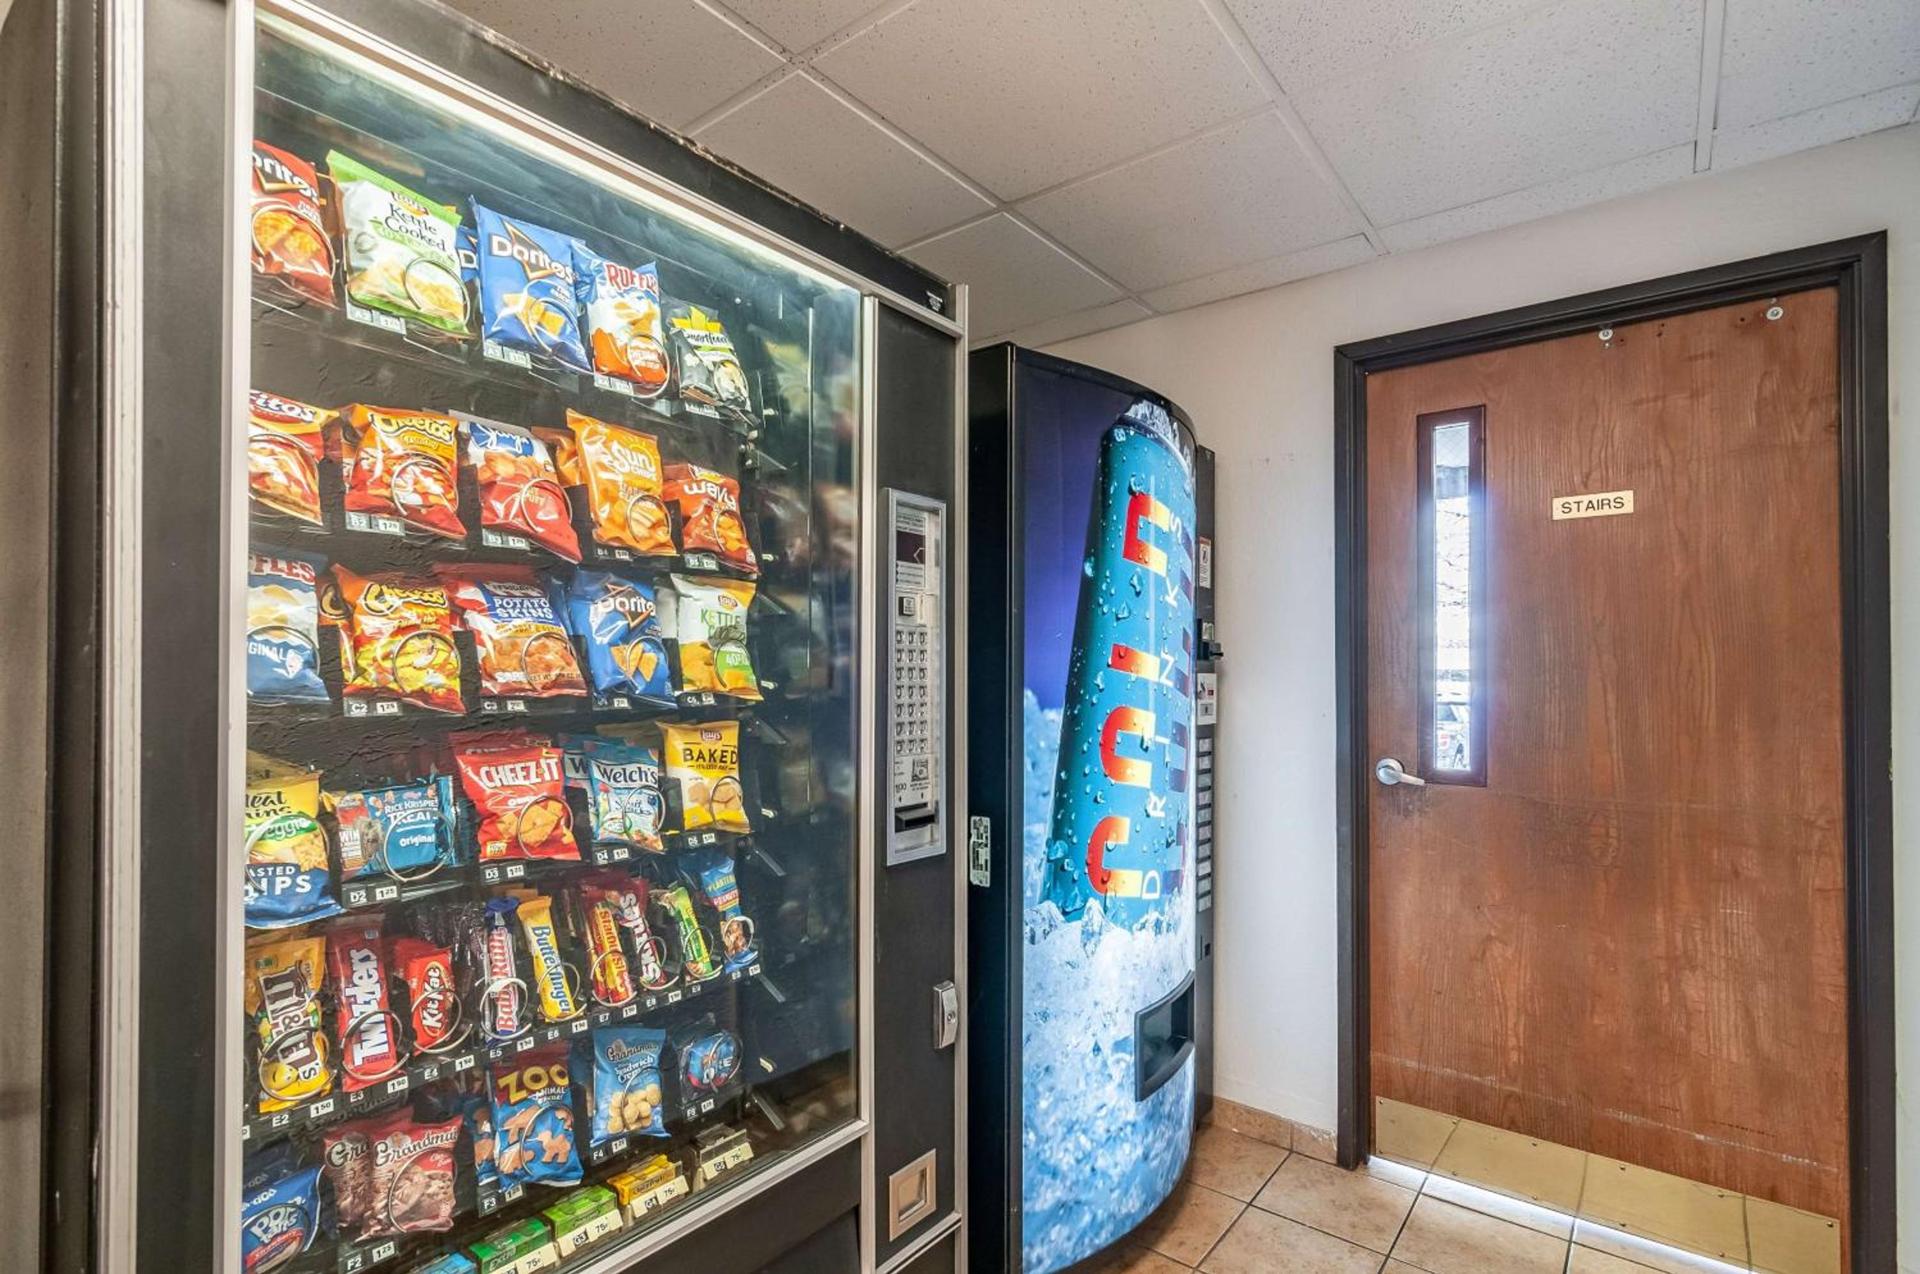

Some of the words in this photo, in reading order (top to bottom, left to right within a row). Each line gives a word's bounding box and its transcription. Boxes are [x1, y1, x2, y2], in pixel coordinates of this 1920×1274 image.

[252, 151, 320, 207] oritos
[389, 203, 438, 235] Kettle
[384, 216, 446, 252] Cooked
[489, 234, 576, 286] Doritos
[250, 390, 317, 423] itos
[1561, 496, 1625, 514] STAIRS
[493, 597, 550, 609] POTATO
[495, 607, 554, 619] SKINS
[597, 596, 656, 616] Dorito
[247, 640, 288, 661] GINAL
[351, 703, 367, 713] C2
[1141, 512, 1183, 900] DRINKS
[683, 748, 738, 765] BAKED
[596, 763, 658, 785] Welch's
[351, 889, 367, 903] D2
[497, 1063, 570, 1105] ZOO
[350, 1090, 364, 1103] E3
[272, 1114, 289, 1128] E2
[374, 1128, 459, 1167] Grandma
[484, 1197, 496, 1209] F3
[347, 1256, 362, 1270] F2
